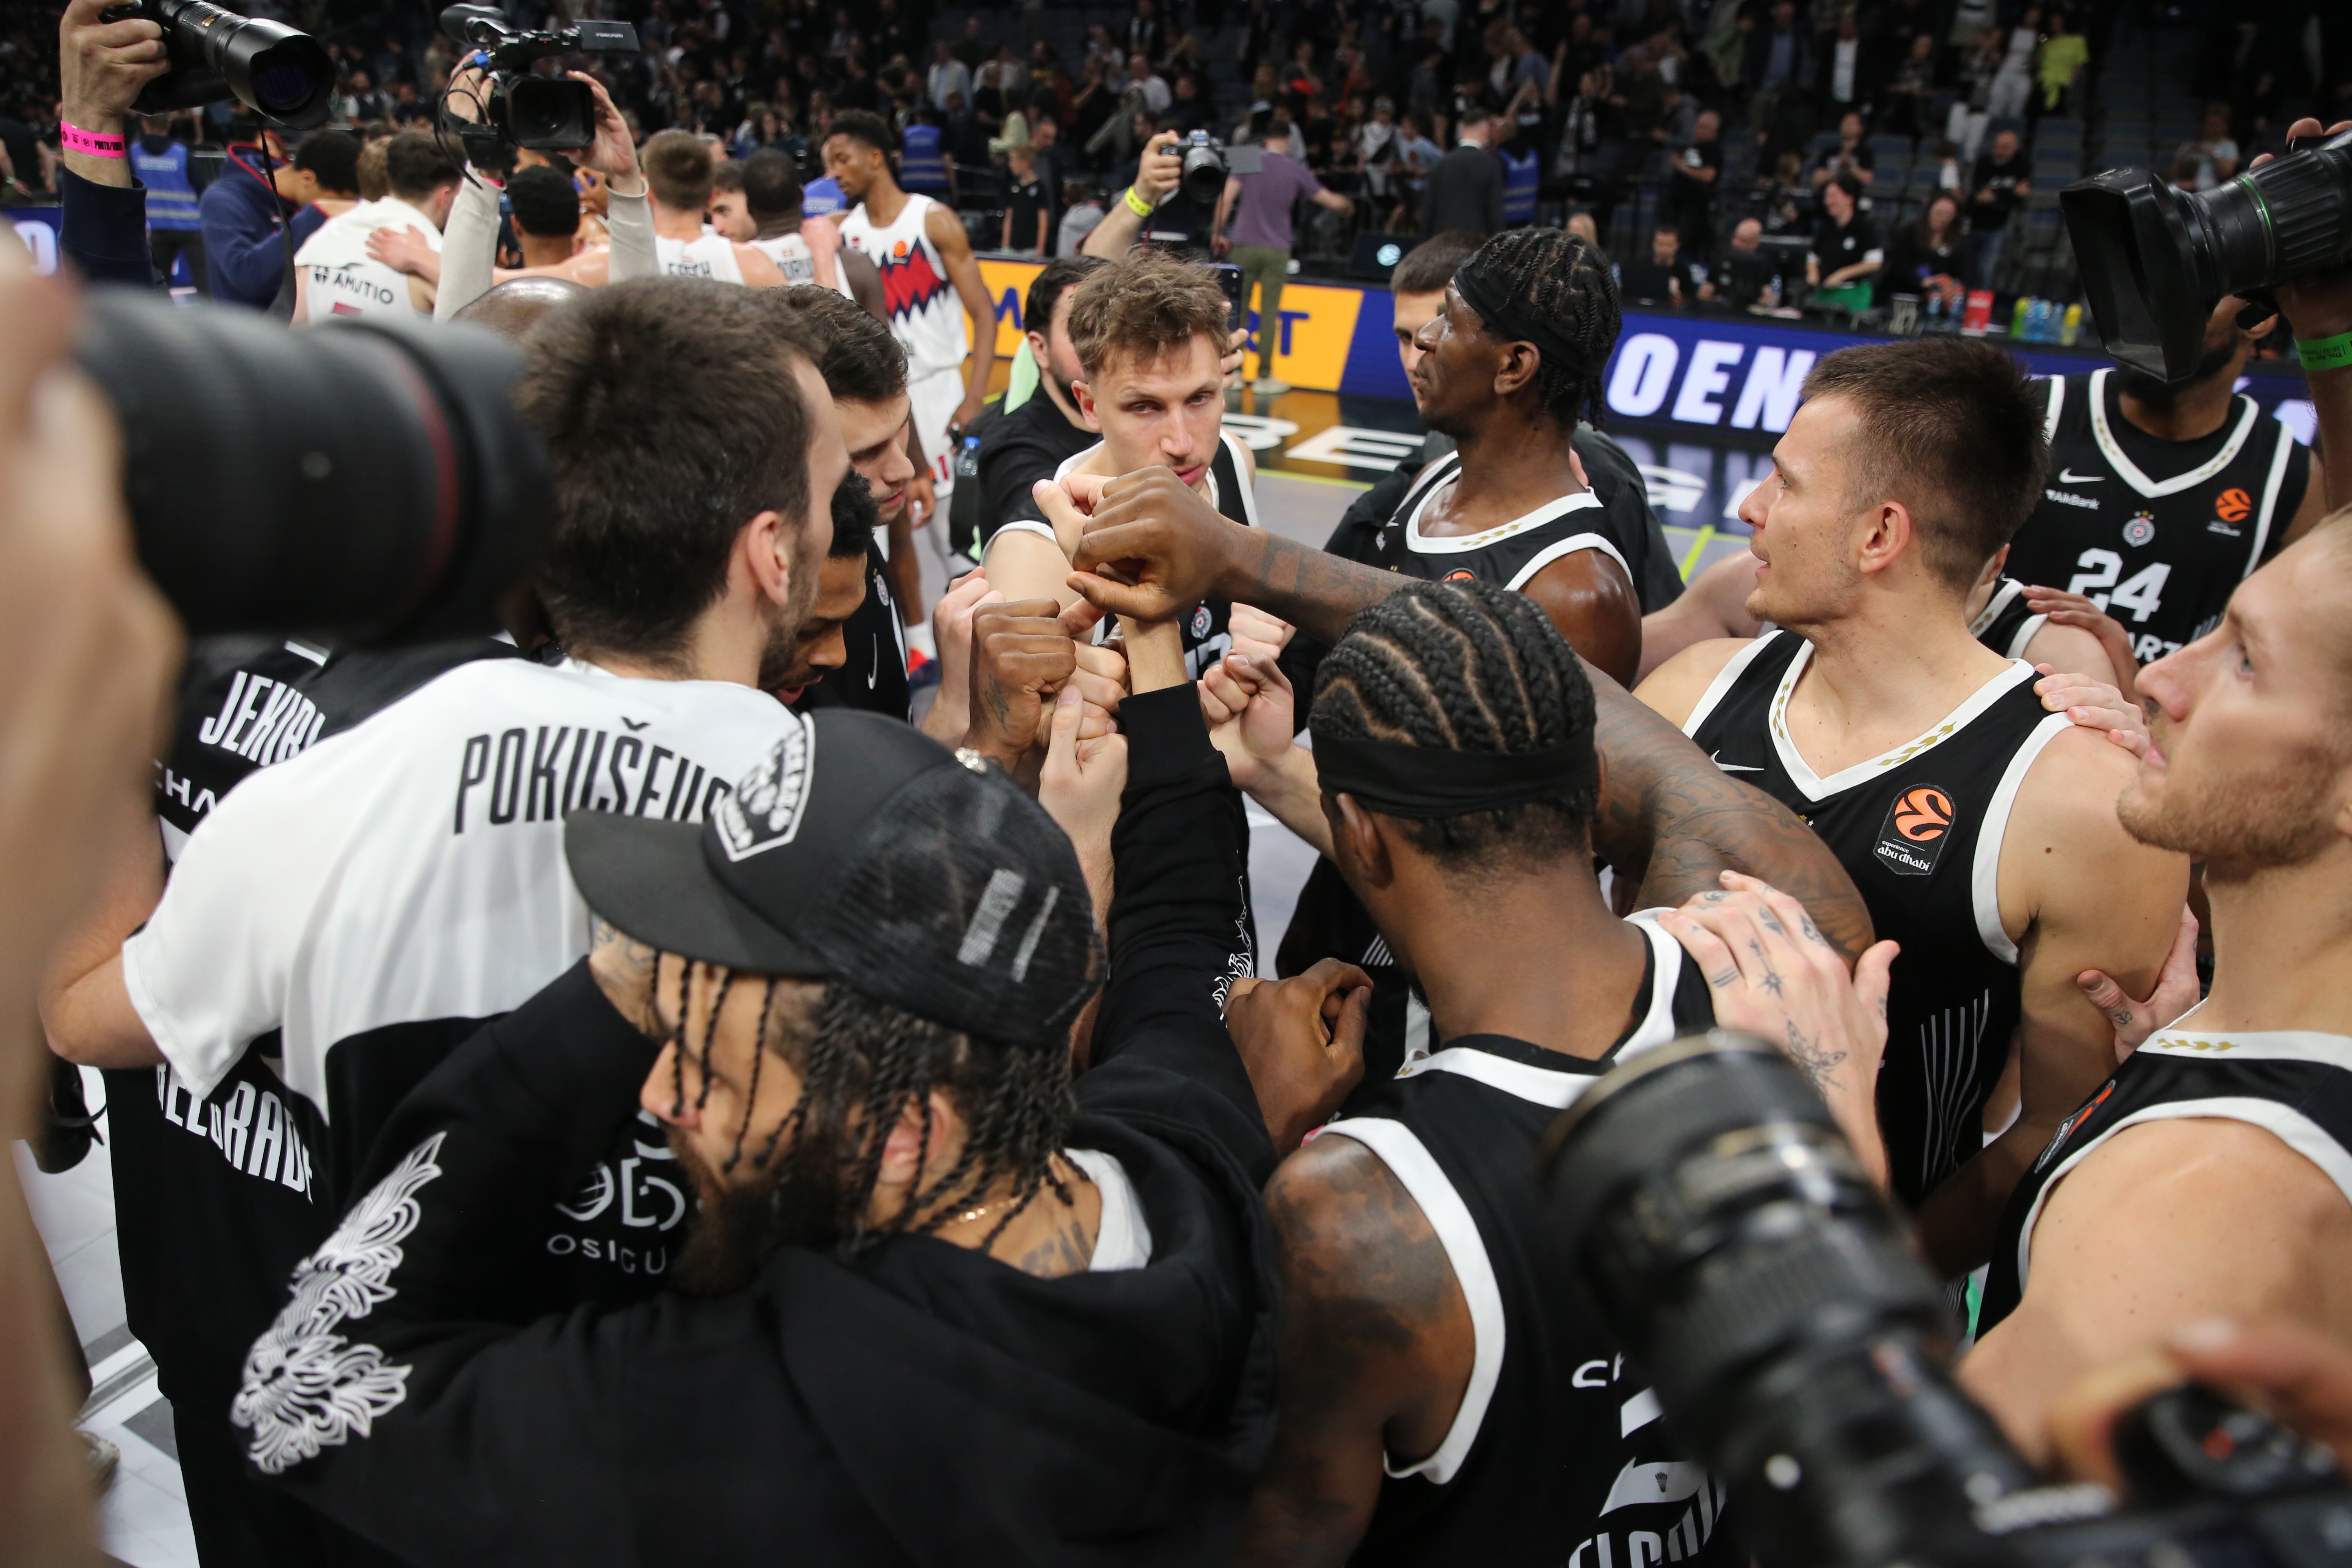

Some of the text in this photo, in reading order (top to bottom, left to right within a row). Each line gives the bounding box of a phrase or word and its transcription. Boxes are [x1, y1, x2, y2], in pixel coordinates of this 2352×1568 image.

[2067, 548, 2172, 622] 24
[1877, 846, 1931, 871] abu dhabi
[1882, 840, 1909, 853] experience
